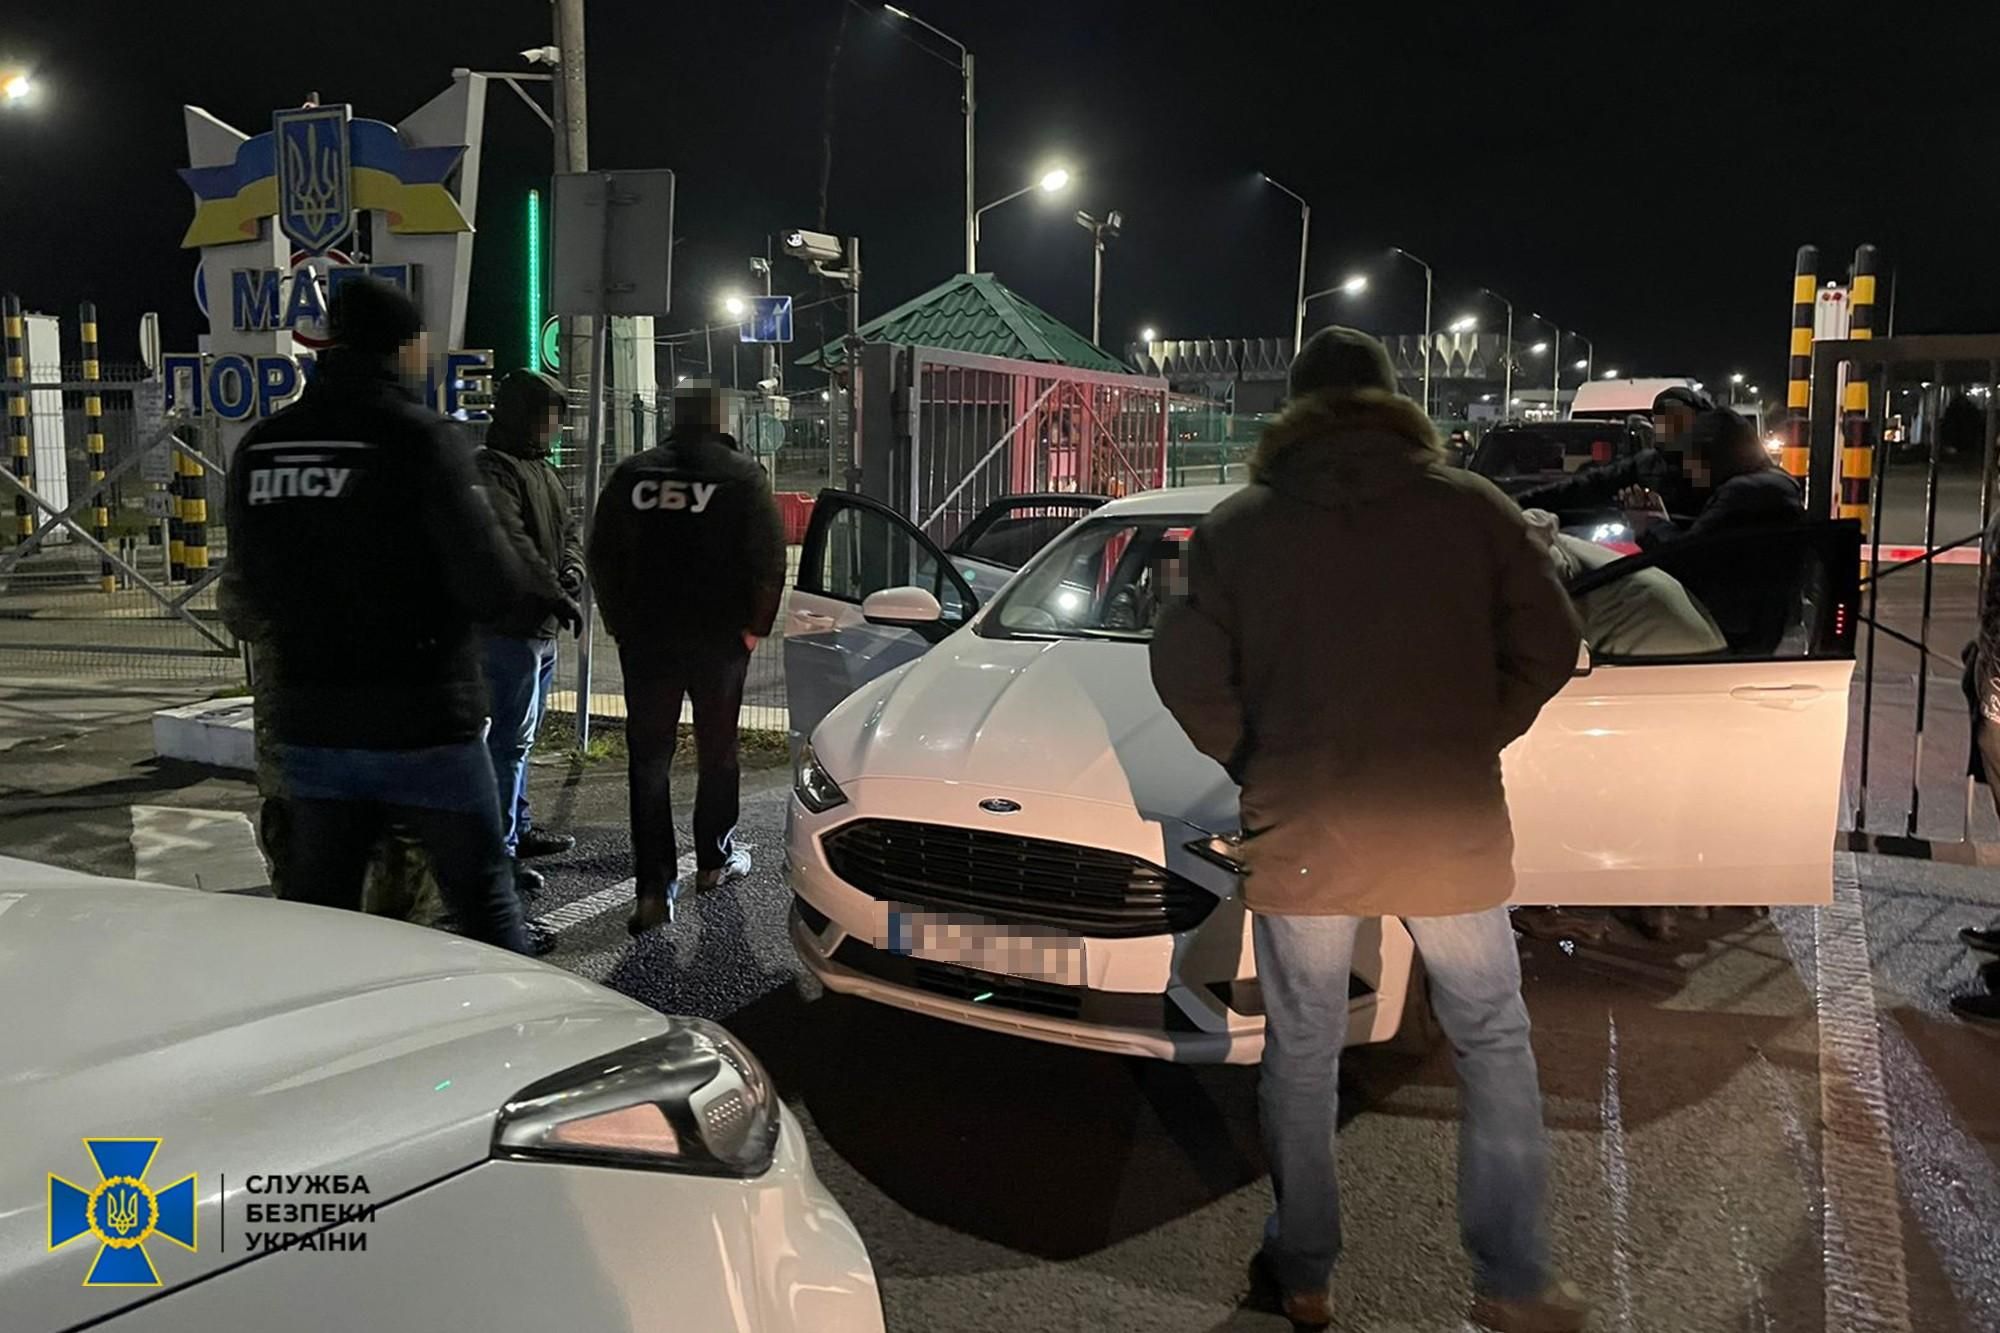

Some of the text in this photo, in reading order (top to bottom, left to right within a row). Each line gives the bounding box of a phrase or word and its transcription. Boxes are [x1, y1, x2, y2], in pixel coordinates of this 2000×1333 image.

[232, 264, 409, 331] МА
[162, 350, 495, 422] ПОРЕ
[248, 467, 351, 506] ДПСУ
[632, 480, 718, 513] СБУ
